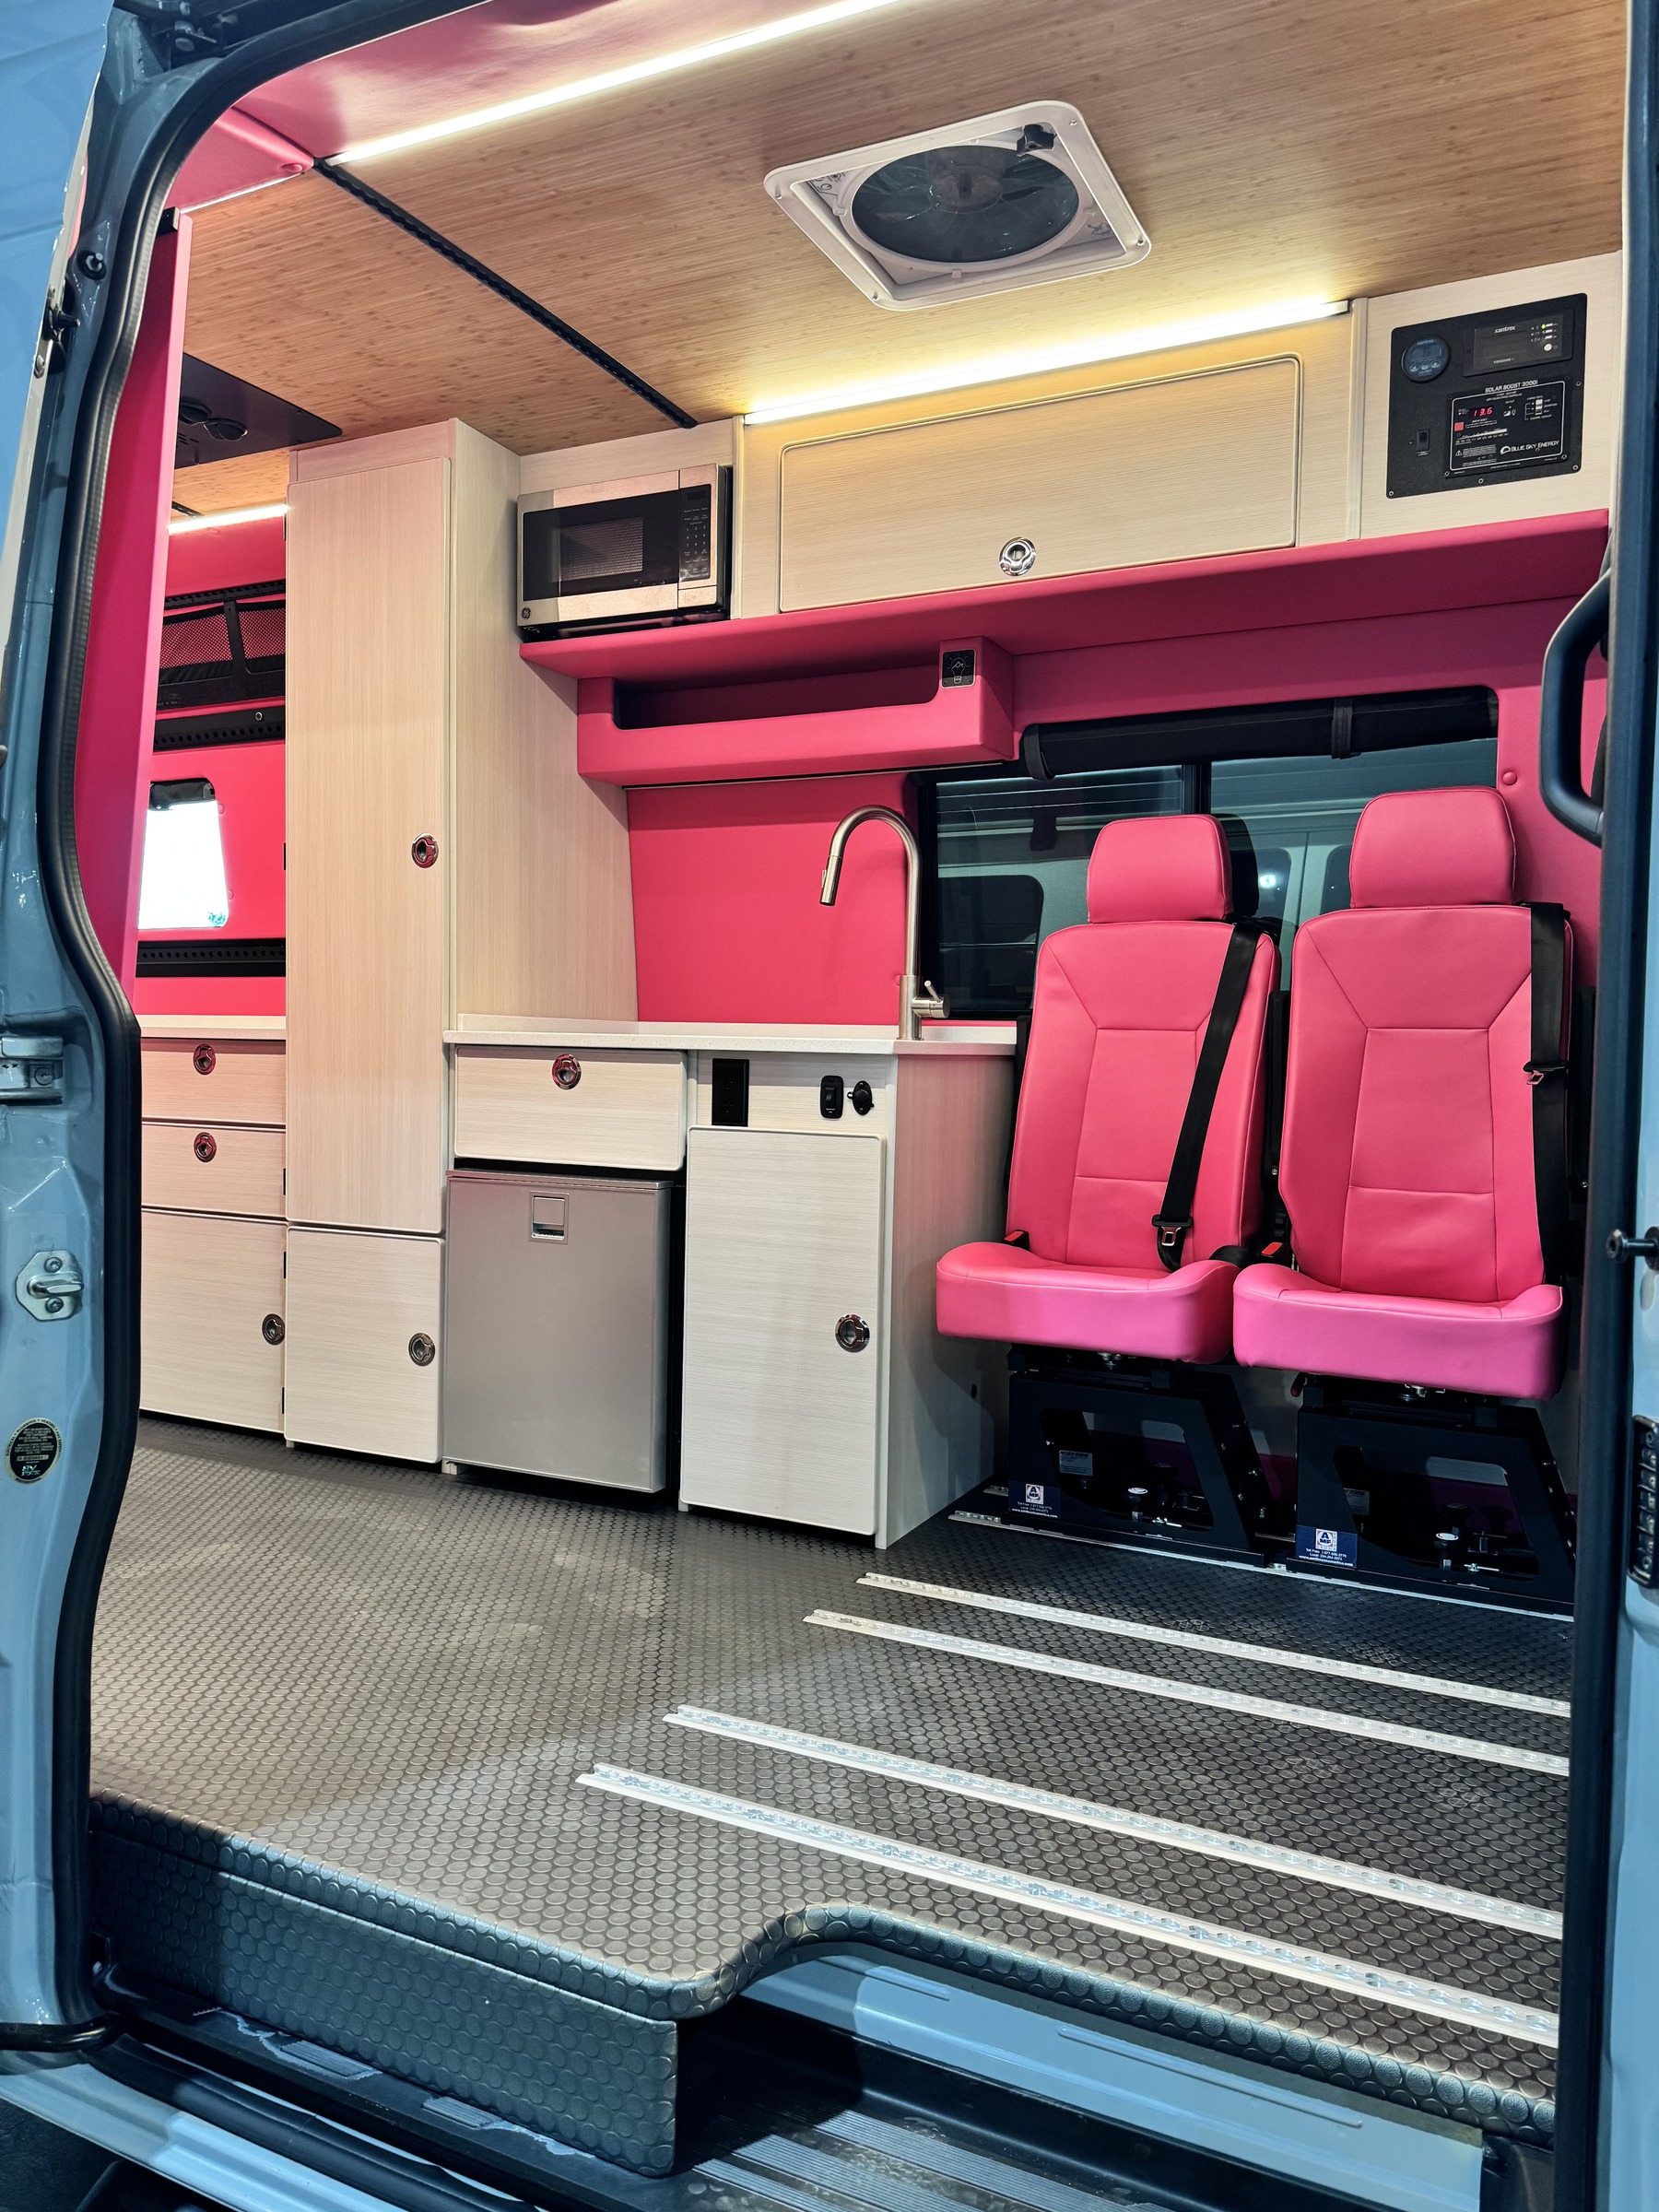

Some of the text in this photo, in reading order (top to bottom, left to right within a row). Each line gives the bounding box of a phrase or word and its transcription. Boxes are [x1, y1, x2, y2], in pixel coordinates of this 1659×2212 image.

[1485, 385, 1502, 394] SOLAR
[1502, 382, 1521, 390] BOOST
[1535, 440, 1559, 452] ENERGY
